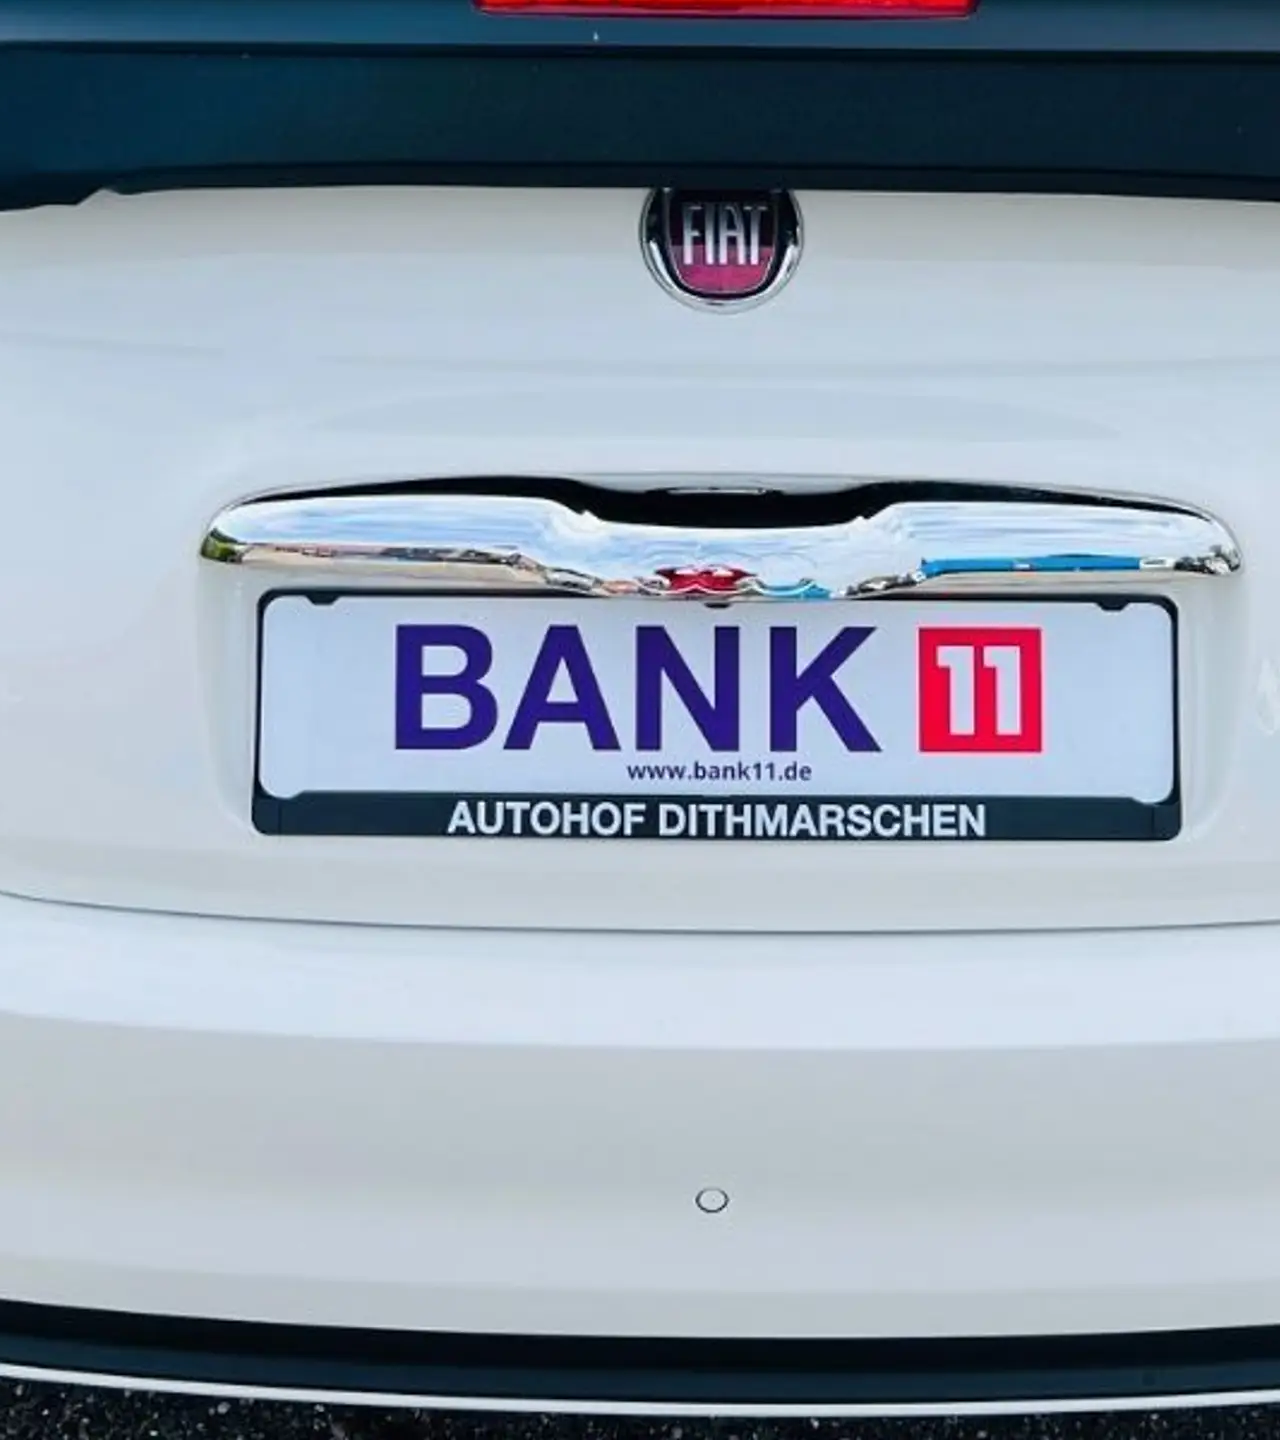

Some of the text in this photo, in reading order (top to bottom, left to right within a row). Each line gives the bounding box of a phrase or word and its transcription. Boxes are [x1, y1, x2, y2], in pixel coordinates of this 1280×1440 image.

[682, 203, 768, 265] FIAT
[394, 623, 1023, 753] BANK 11
[626, 761, 813, 784] www.bank11.de
[447, 800, 987, 839] AUTOHOF DITHMARSCHEN
